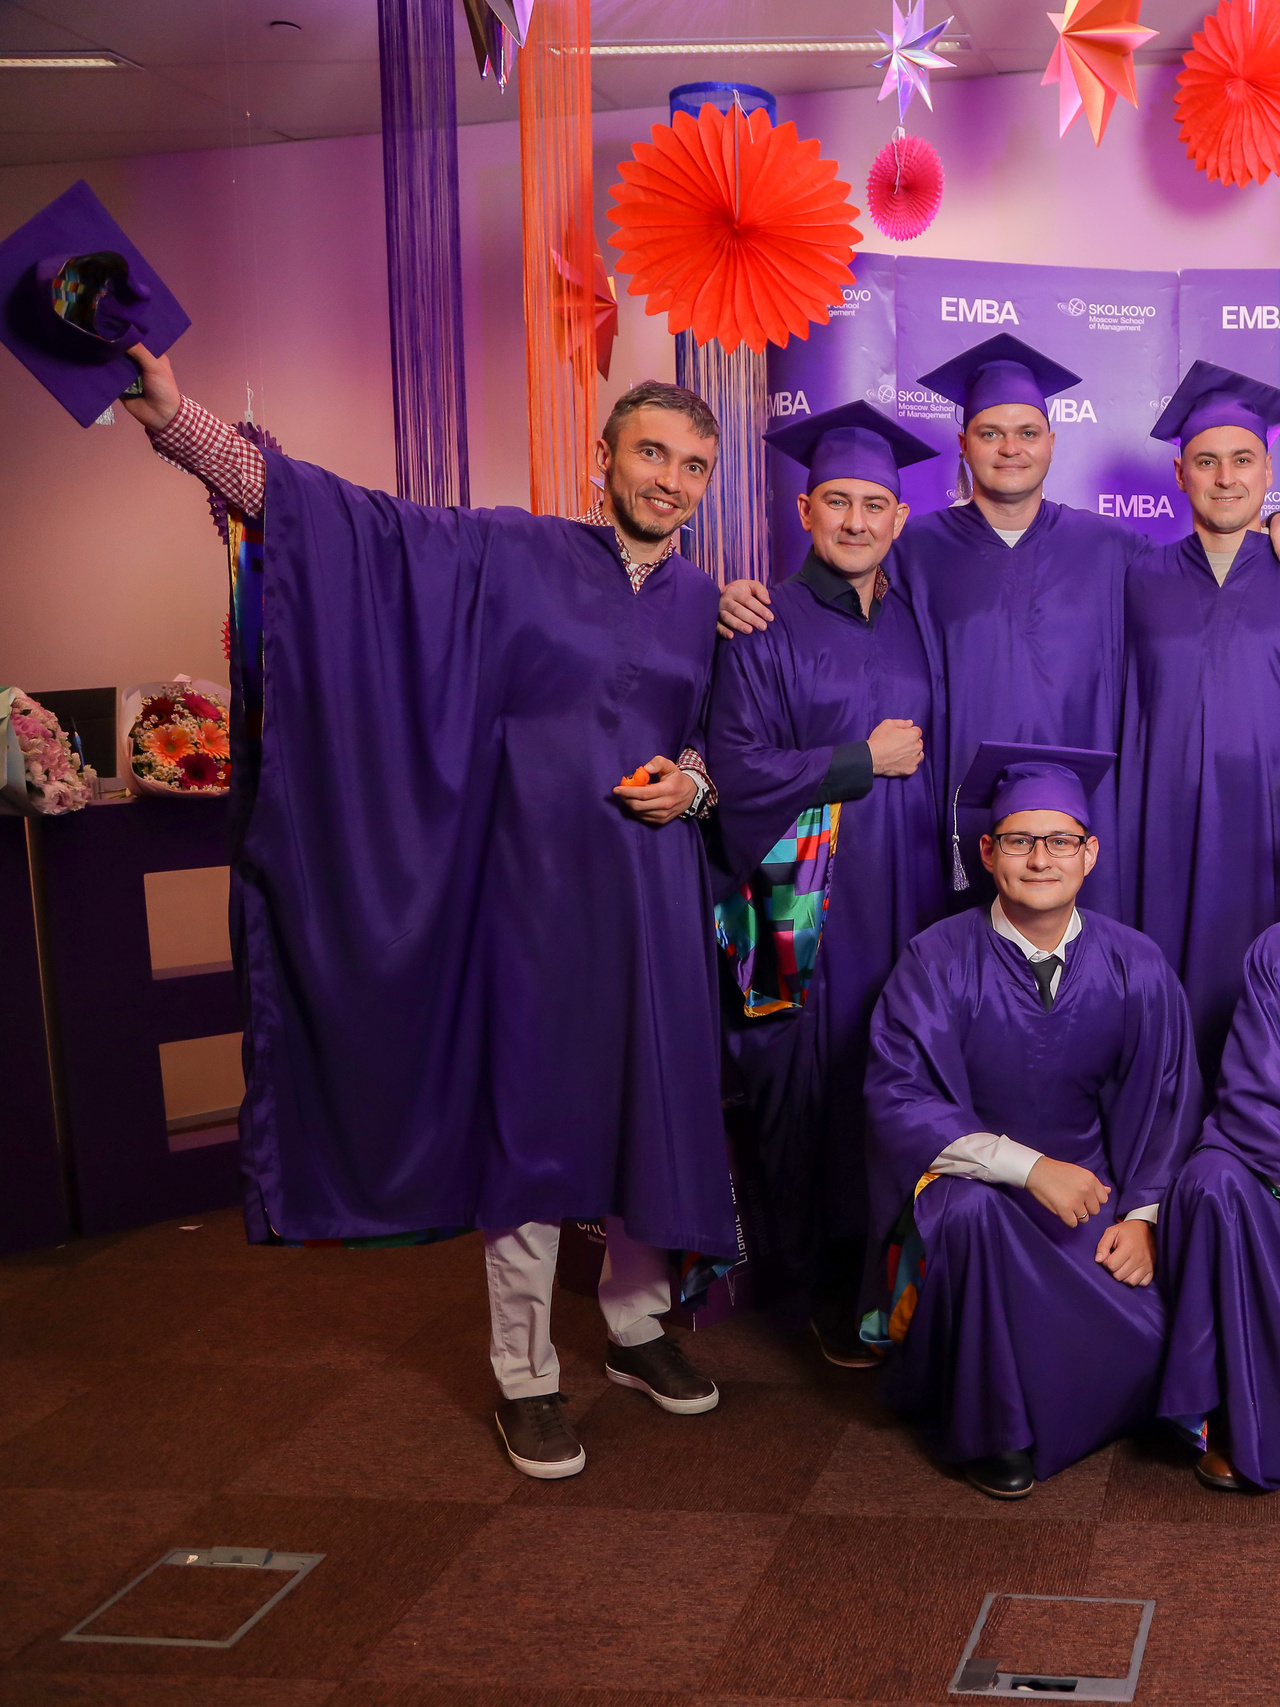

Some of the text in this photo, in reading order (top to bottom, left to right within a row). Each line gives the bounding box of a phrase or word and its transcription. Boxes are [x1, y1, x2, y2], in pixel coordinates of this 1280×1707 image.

[828, 309, 856, 317] gement
[941, 296, 1020, 325] EMBA
[1088, 303, 1156, 317] SKOLKOVO
[1088, 315, 1145, 325] Moscow School
[1088, 322, 1141, 332] of Management
[767, 390, 812, 417] MBA
[898, 390, 954, 404] SKOLKO
[898, 402, 955, 412] Moscow School
[1048, 398, 1098, 423] MBA
[906, 410, 952, 419] Management
[1098, 494, 1175, 518] EMBA
